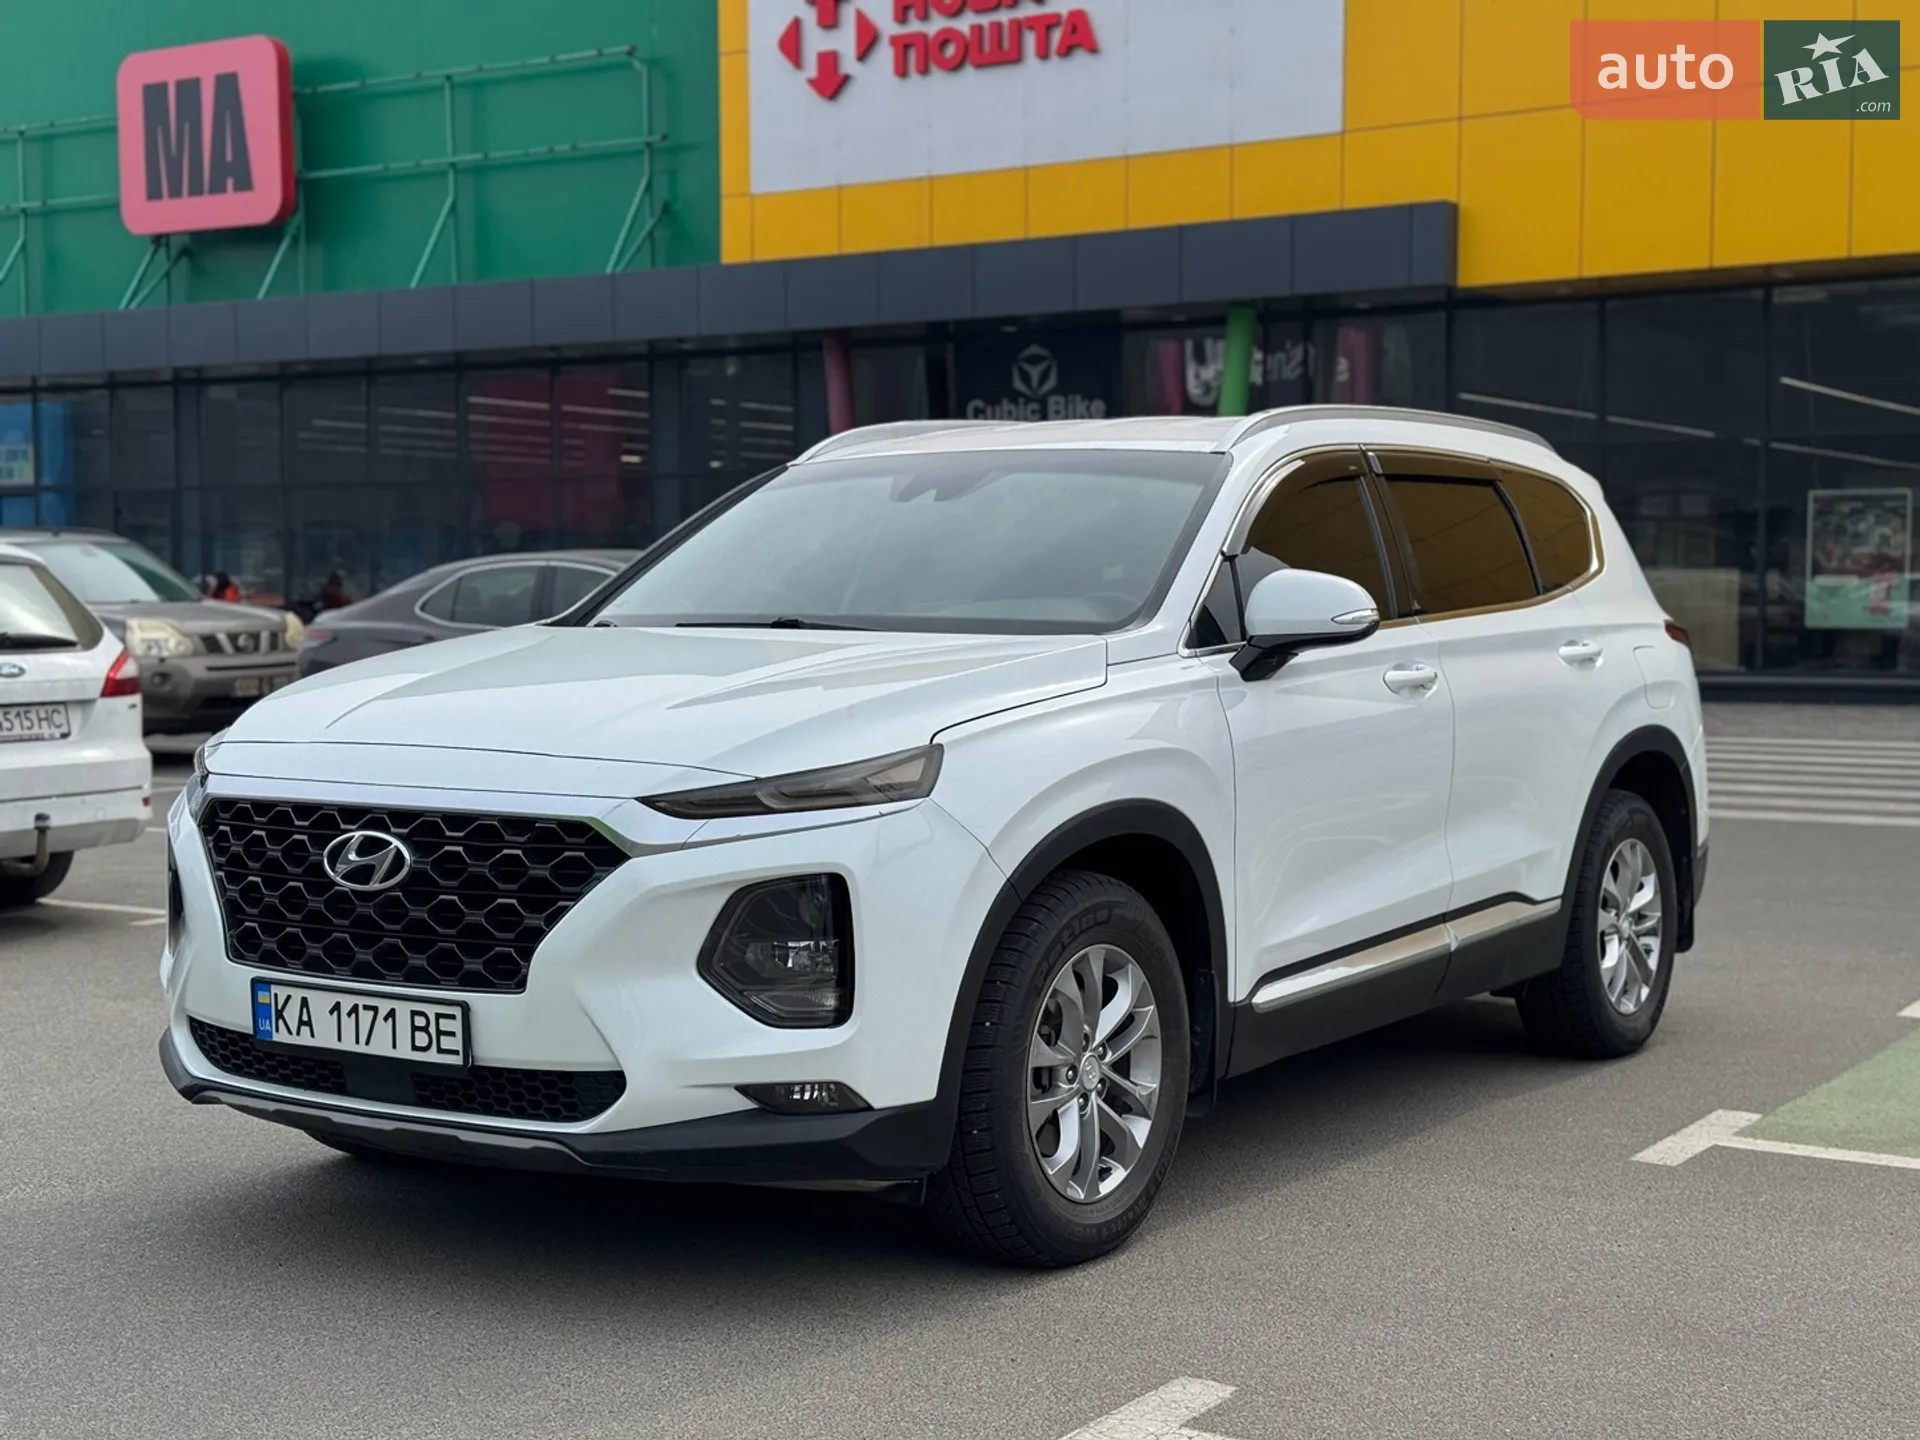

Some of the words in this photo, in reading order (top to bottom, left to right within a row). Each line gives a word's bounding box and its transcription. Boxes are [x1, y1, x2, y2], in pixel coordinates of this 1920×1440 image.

[889, 8, 1099, 78] ПОШТА
[142, 71, 254, 203] MA
[966, 397, 1041, 421] Cubic
[1047, 394, 1107, 420] Bike
[0, 709, 35, 733] 515
[258, 1017, 271, 1032] UA
[273, 992, 316, 1039] KA
[328, 1000, 397, 1049] 1171
[409, 1008, 461, 1056] BE
